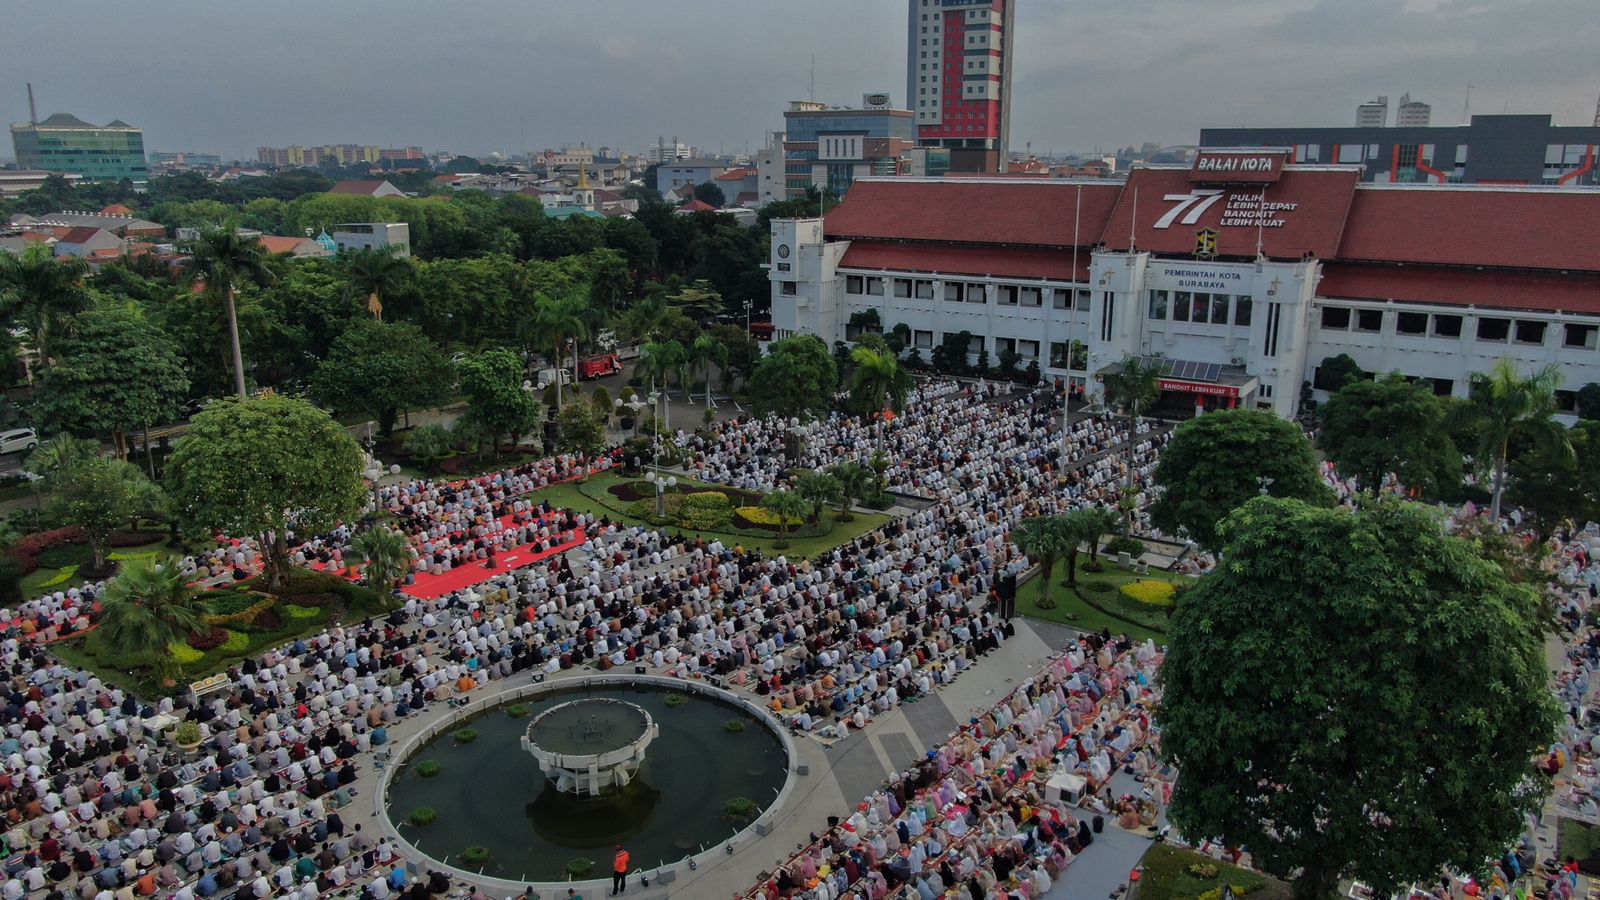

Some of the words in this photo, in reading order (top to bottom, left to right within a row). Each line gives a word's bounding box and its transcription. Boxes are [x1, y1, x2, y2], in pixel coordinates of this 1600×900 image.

[1199, 158, 1238, 171] BALAI
[1240, 158, 1272, 171] KOTA
[1229, 194, 1263, 202] PULIH
[1262, 202, 1298, 210] CEPAT
[1224, 210, 1275, 218] BANGKIT
[1220, 218, 1253, 226] LEBIH
[1254, 219, 1286, 227] KUAT
[1165, 269, 1215, 278] PEMERINTAH
[1219, 272, 1241, 280] KOTA
[1178, 280, 1225, 289] SURABAYA
[1163, 383, 1190, 391] BANGKIT
